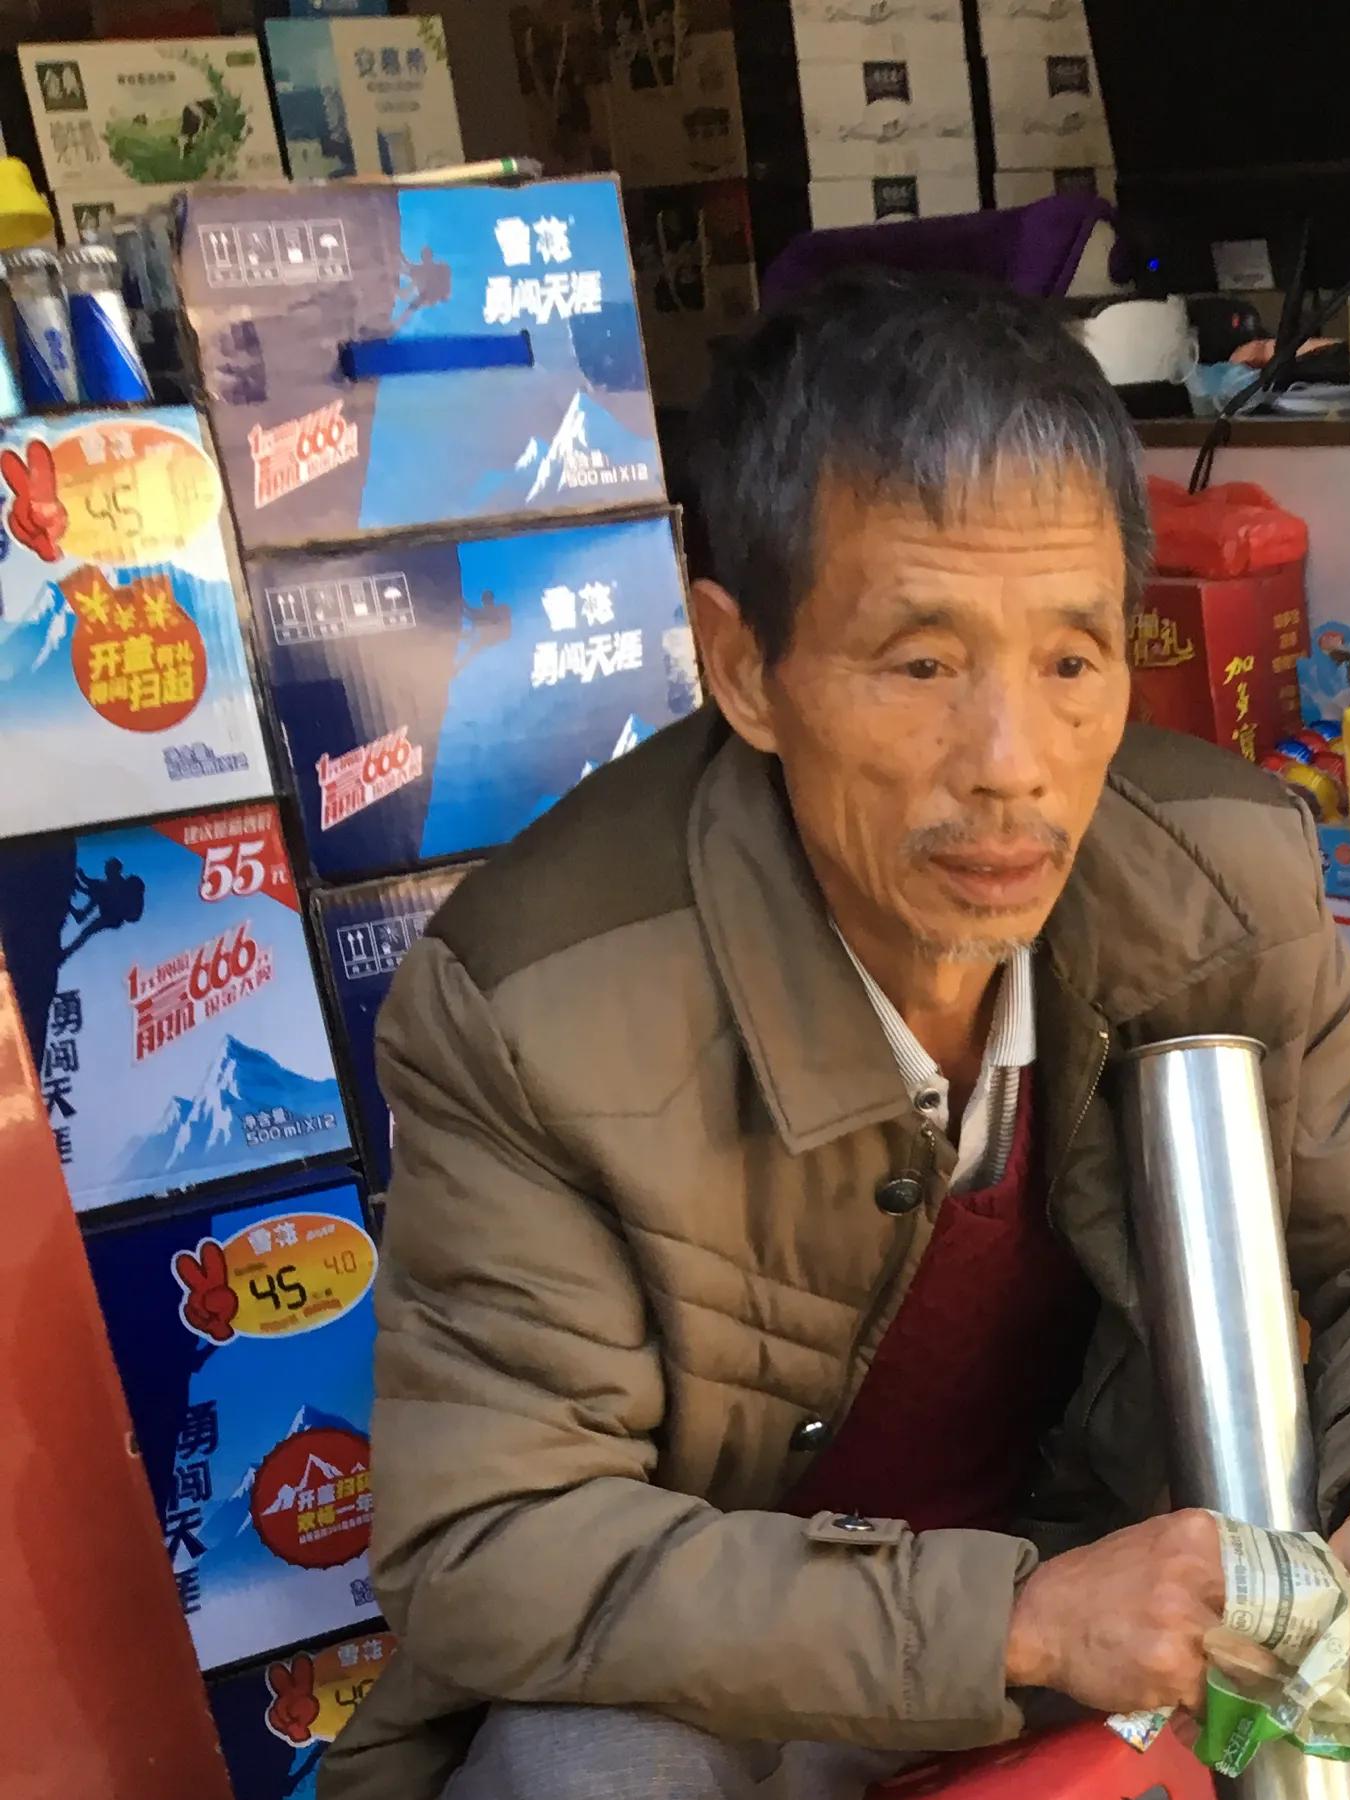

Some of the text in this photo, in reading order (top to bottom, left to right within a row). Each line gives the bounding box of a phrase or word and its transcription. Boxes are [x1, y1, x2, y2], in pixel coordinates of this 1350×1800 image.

[483, 271, 602, 326] 勇闯天涯
[531, 629, 643, 688] 勇闯天涯
[200, 840, 266, 902] 55
[189, 924, 257, 1000] 666
[249, 1264, 307, 1310] 45
